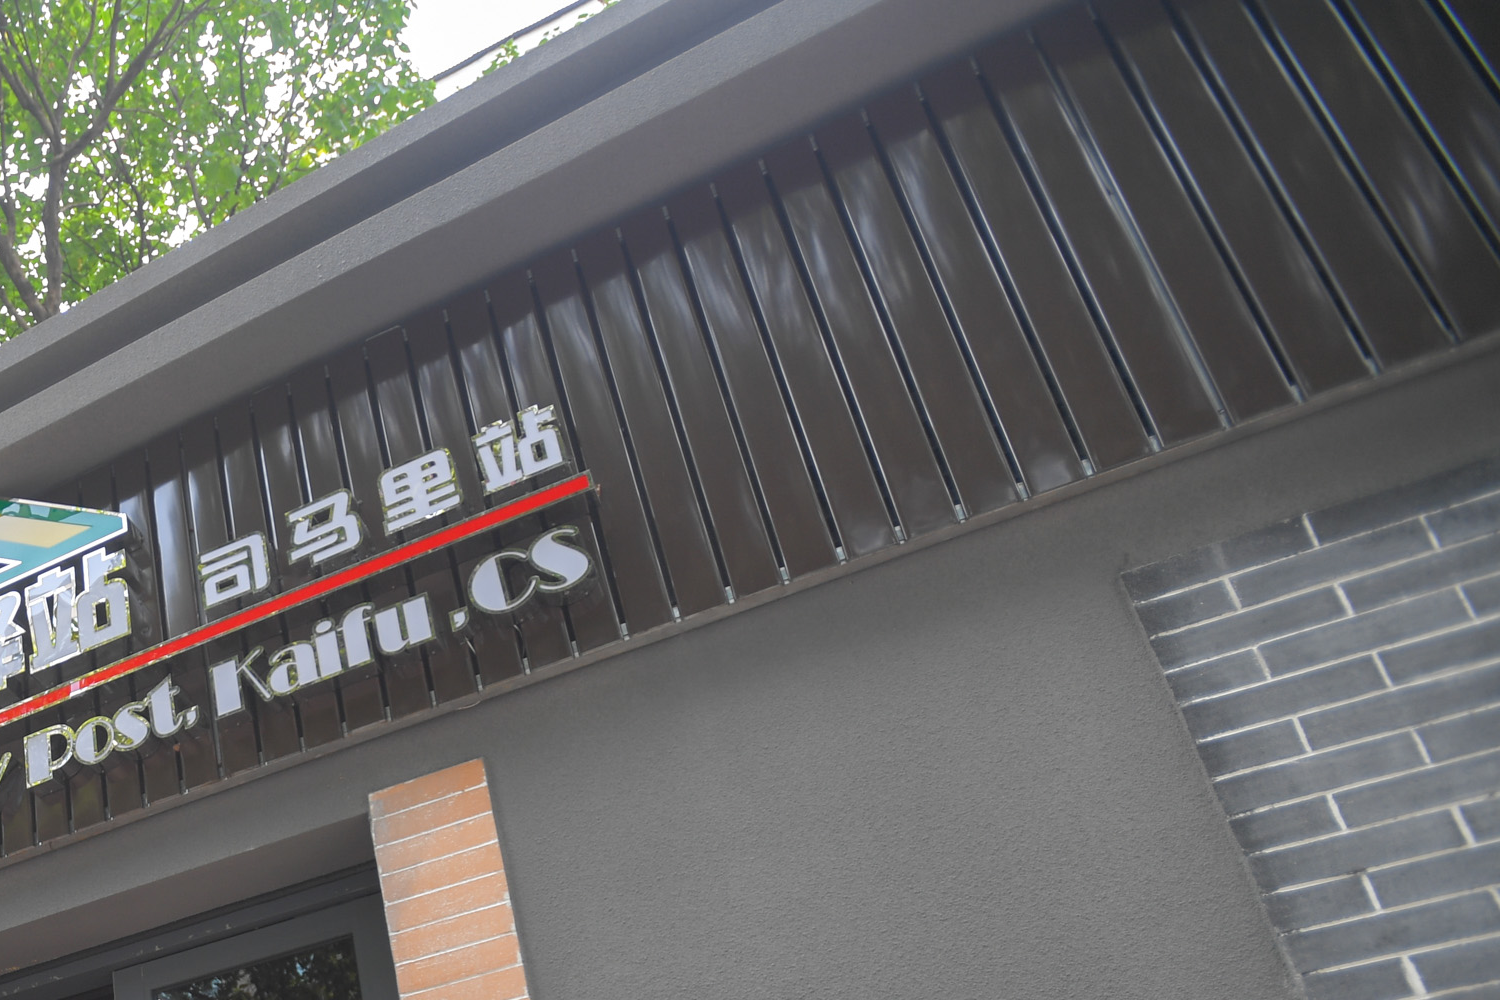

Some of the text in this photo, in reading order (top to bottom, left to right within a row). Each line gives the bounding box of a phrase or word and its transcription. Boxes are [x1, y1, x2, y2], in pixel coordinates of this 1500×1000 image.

[197, 404, 565, 609] 司马里站
[23, 673, 199, 789] Post,
